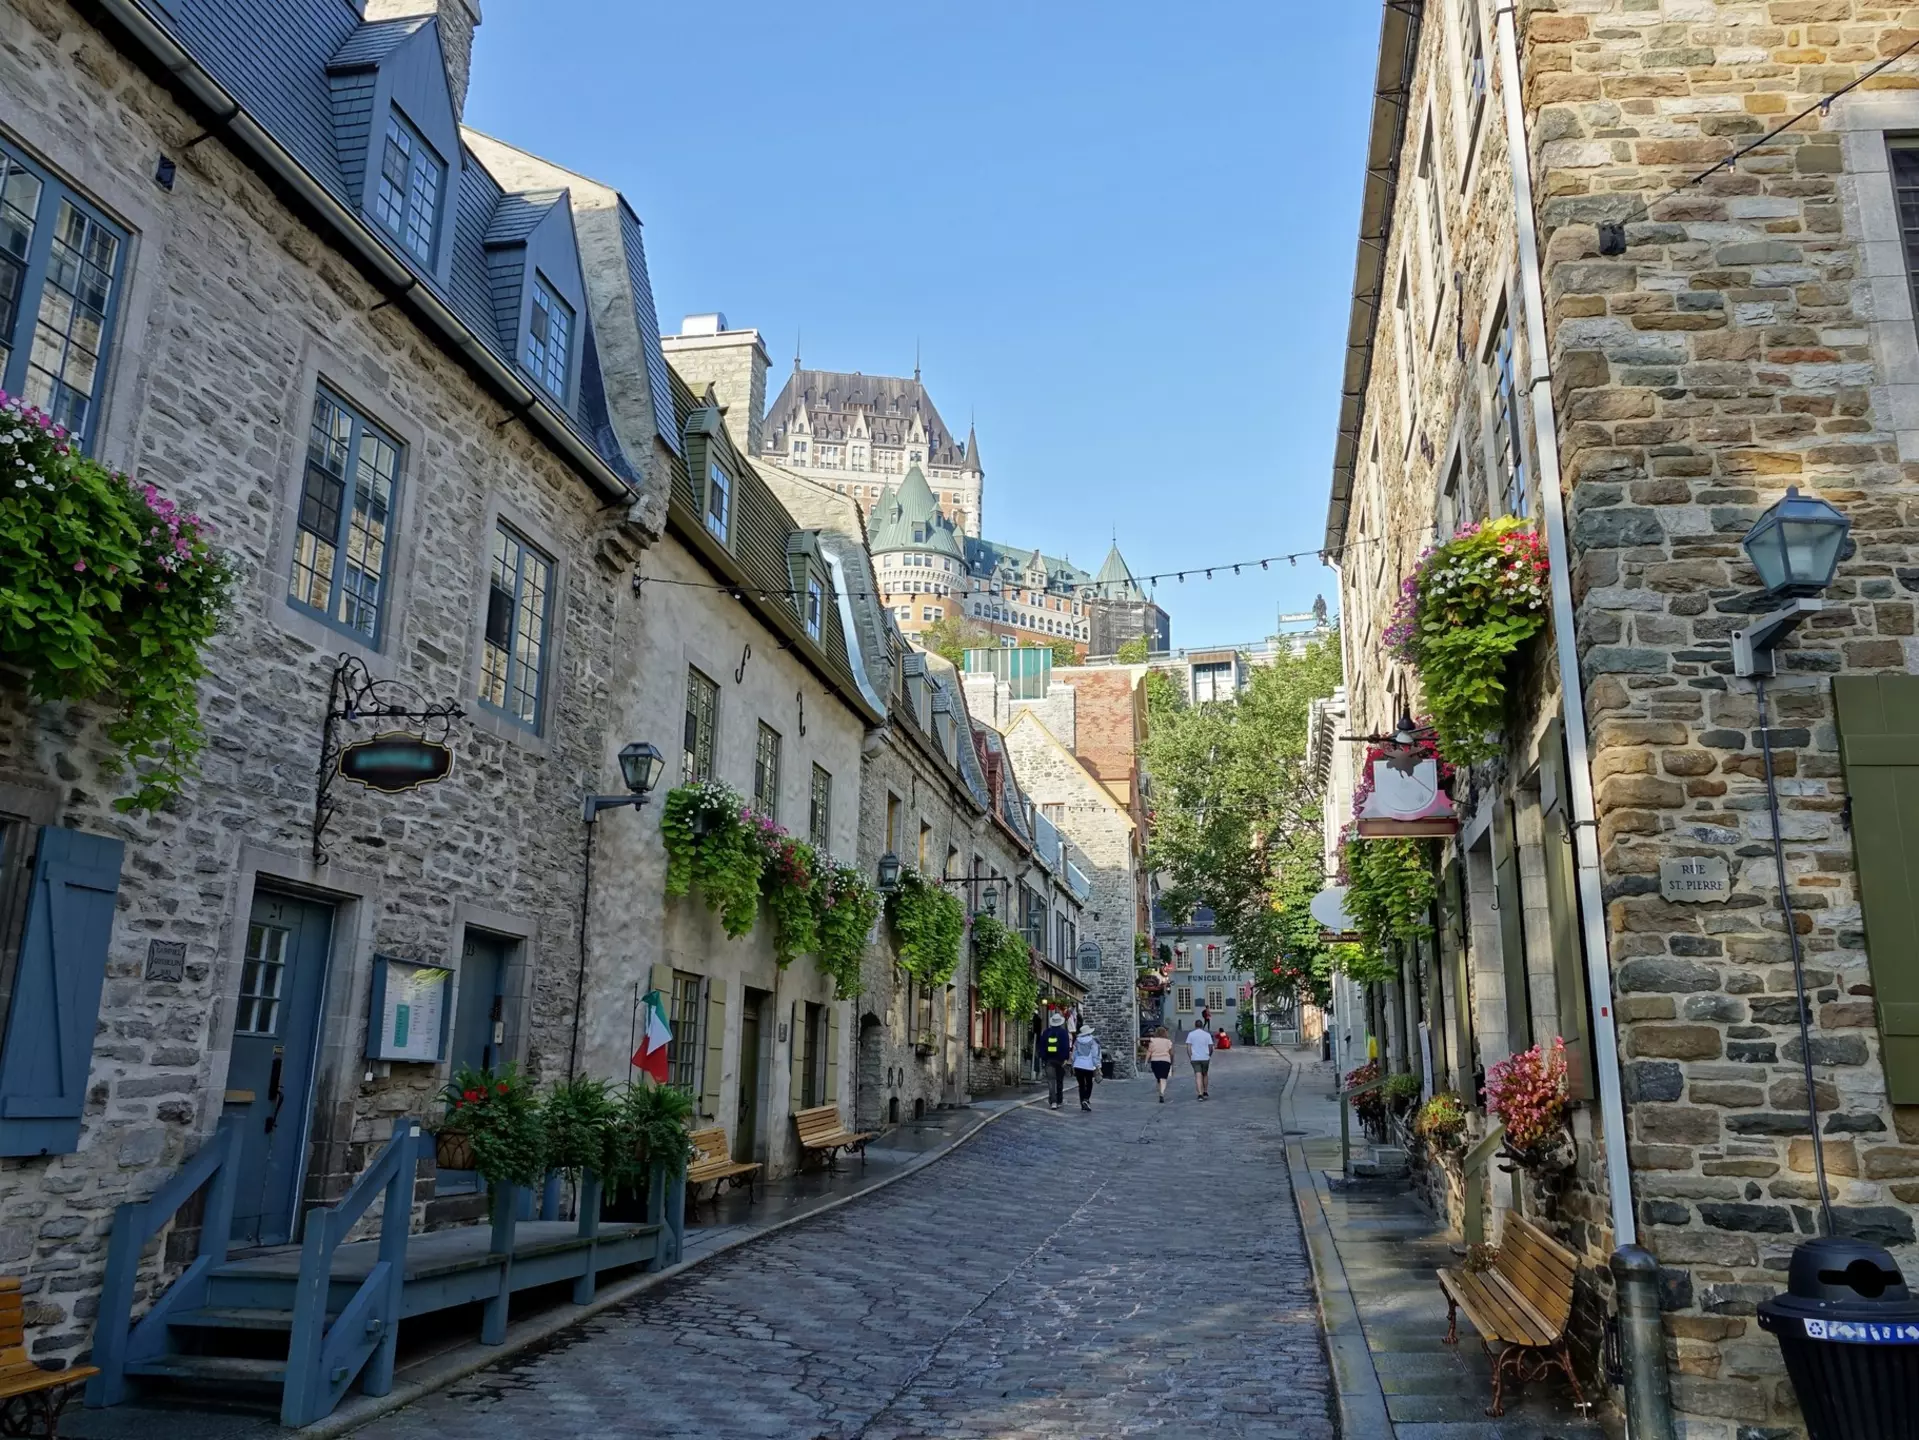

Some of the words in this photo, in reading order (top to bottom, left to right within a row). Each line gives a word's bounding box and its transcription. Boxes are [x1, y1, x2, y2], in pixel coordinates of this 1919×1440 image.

[1681, 864, 1706, 875] RUE
[1669, 880, 1684, 890] ST.
[1686, 880, 1724, 890] PIERRE
[269, 903, 284, 921] 21
[1187, 974, 1242, 982] FUNICULAIRE
